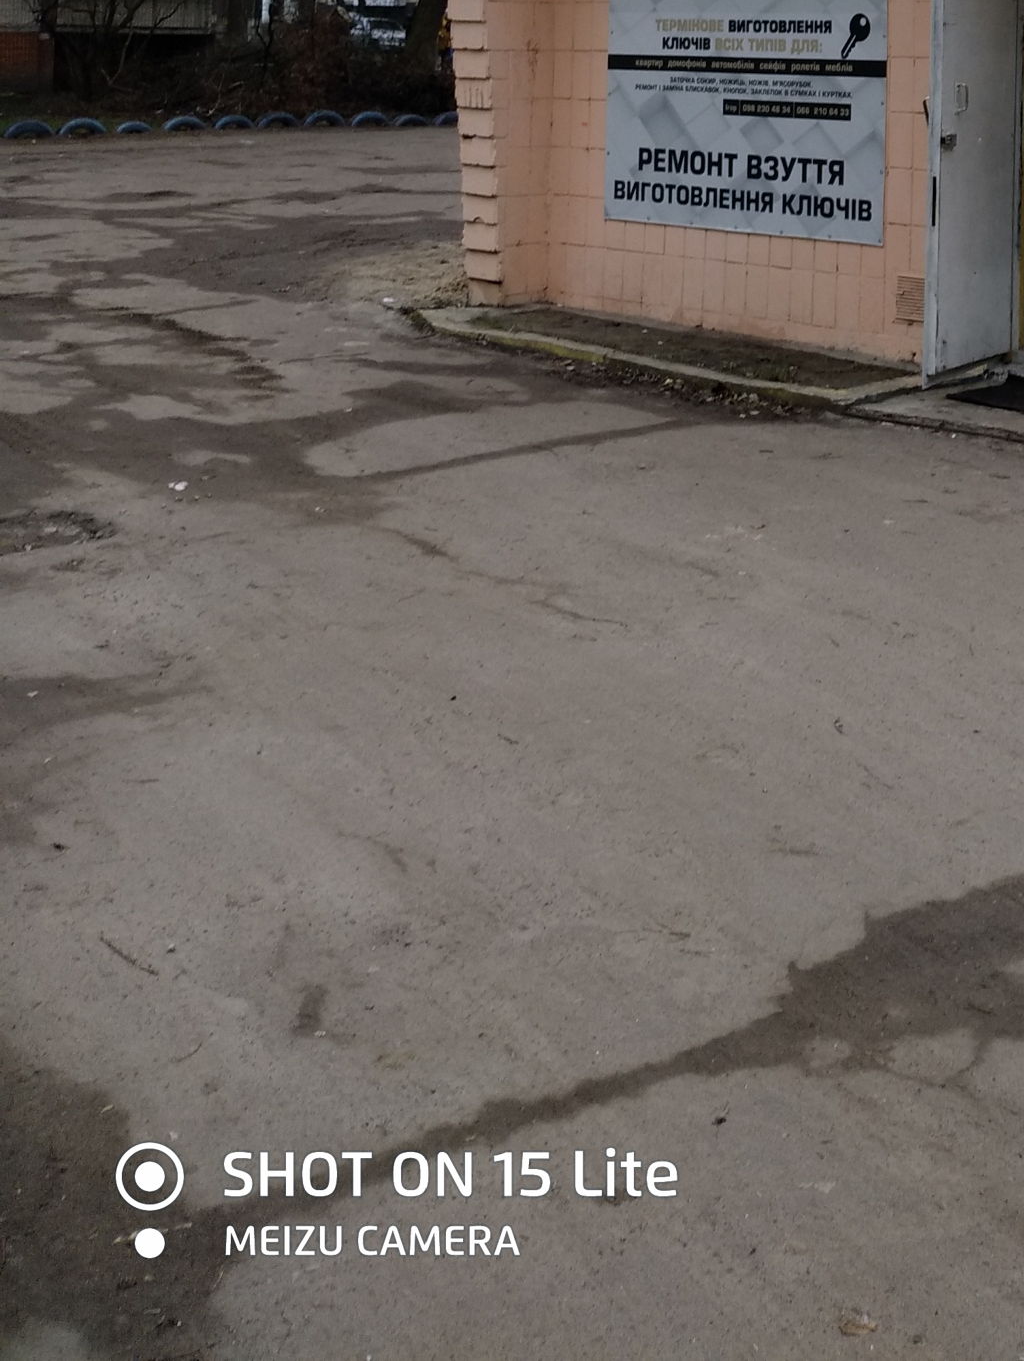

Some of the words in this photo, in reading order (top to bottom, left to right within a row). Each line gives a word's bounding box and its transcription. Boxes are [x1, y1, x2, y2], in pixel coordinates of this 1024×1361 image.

[656, 19, 724, 32] ТЕРМІНОВЕ
[728, 20, 832, 34] ВИГОТОВЛЕННЯ
[662, 37, 711, 50] КЛЮЧІВ
[715, 38, 744, 51] ВСІХ
[749, 38, 786, 52] ТИПІВ
[790, 39, 823, 54] ДЛЯ:
[635, 59, 663, 69] квартир
[668, 59, 706, 70] домофонів
[711, 61, 754, 70] автомобілів
[759, 61, 786, 72] сейфів
[791, 63, 820, 73] ролетів
[825, 63, 853, 73] меблів
[670, 76, 695, 84] ЗАТОЧКА
[662, 84, 684, 92] ЗАМІНА
[790, 89, 817, 97] СУМКАХ
[638, 147, 738, 177] РЕМОНТ
[747, 155, 845, 186] ВЗУТТЯ
[613, 180, 774, 214] ВИГОТОВЛЕННЯ
[782, 194, 872, 222] КЛЮЧІВ
